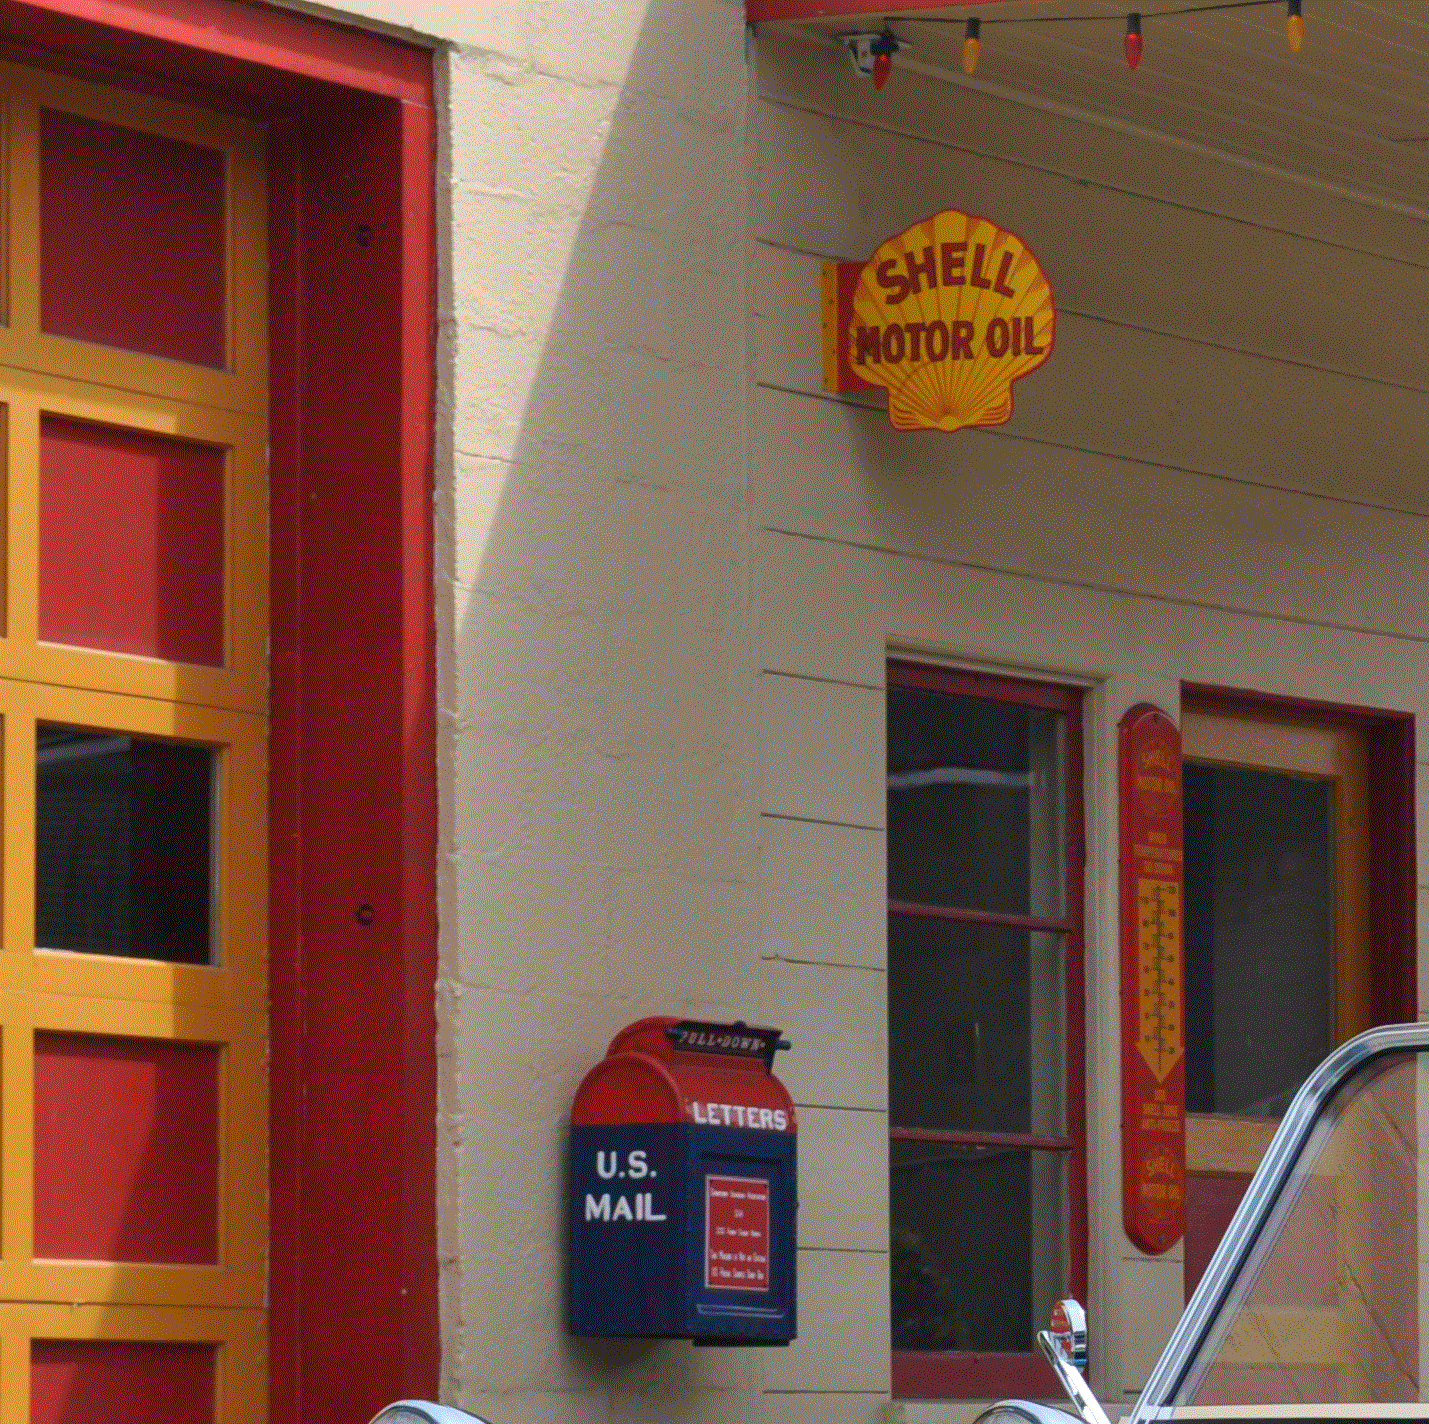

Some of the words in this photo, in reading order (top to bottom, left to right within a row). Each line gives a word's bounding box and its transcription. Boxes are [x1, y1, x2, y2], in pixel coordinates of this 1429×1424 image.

[876, 241, 1015, 304] SHELL
[856, 320, 975, 366] MOTOR
[986, 317, 1044, 358] OIL
[692, 1101, 788, 1131] LETTERS
[597, 1151, 657, 1179] U.S.
[585, 1193, 667, 1221] MAIL
